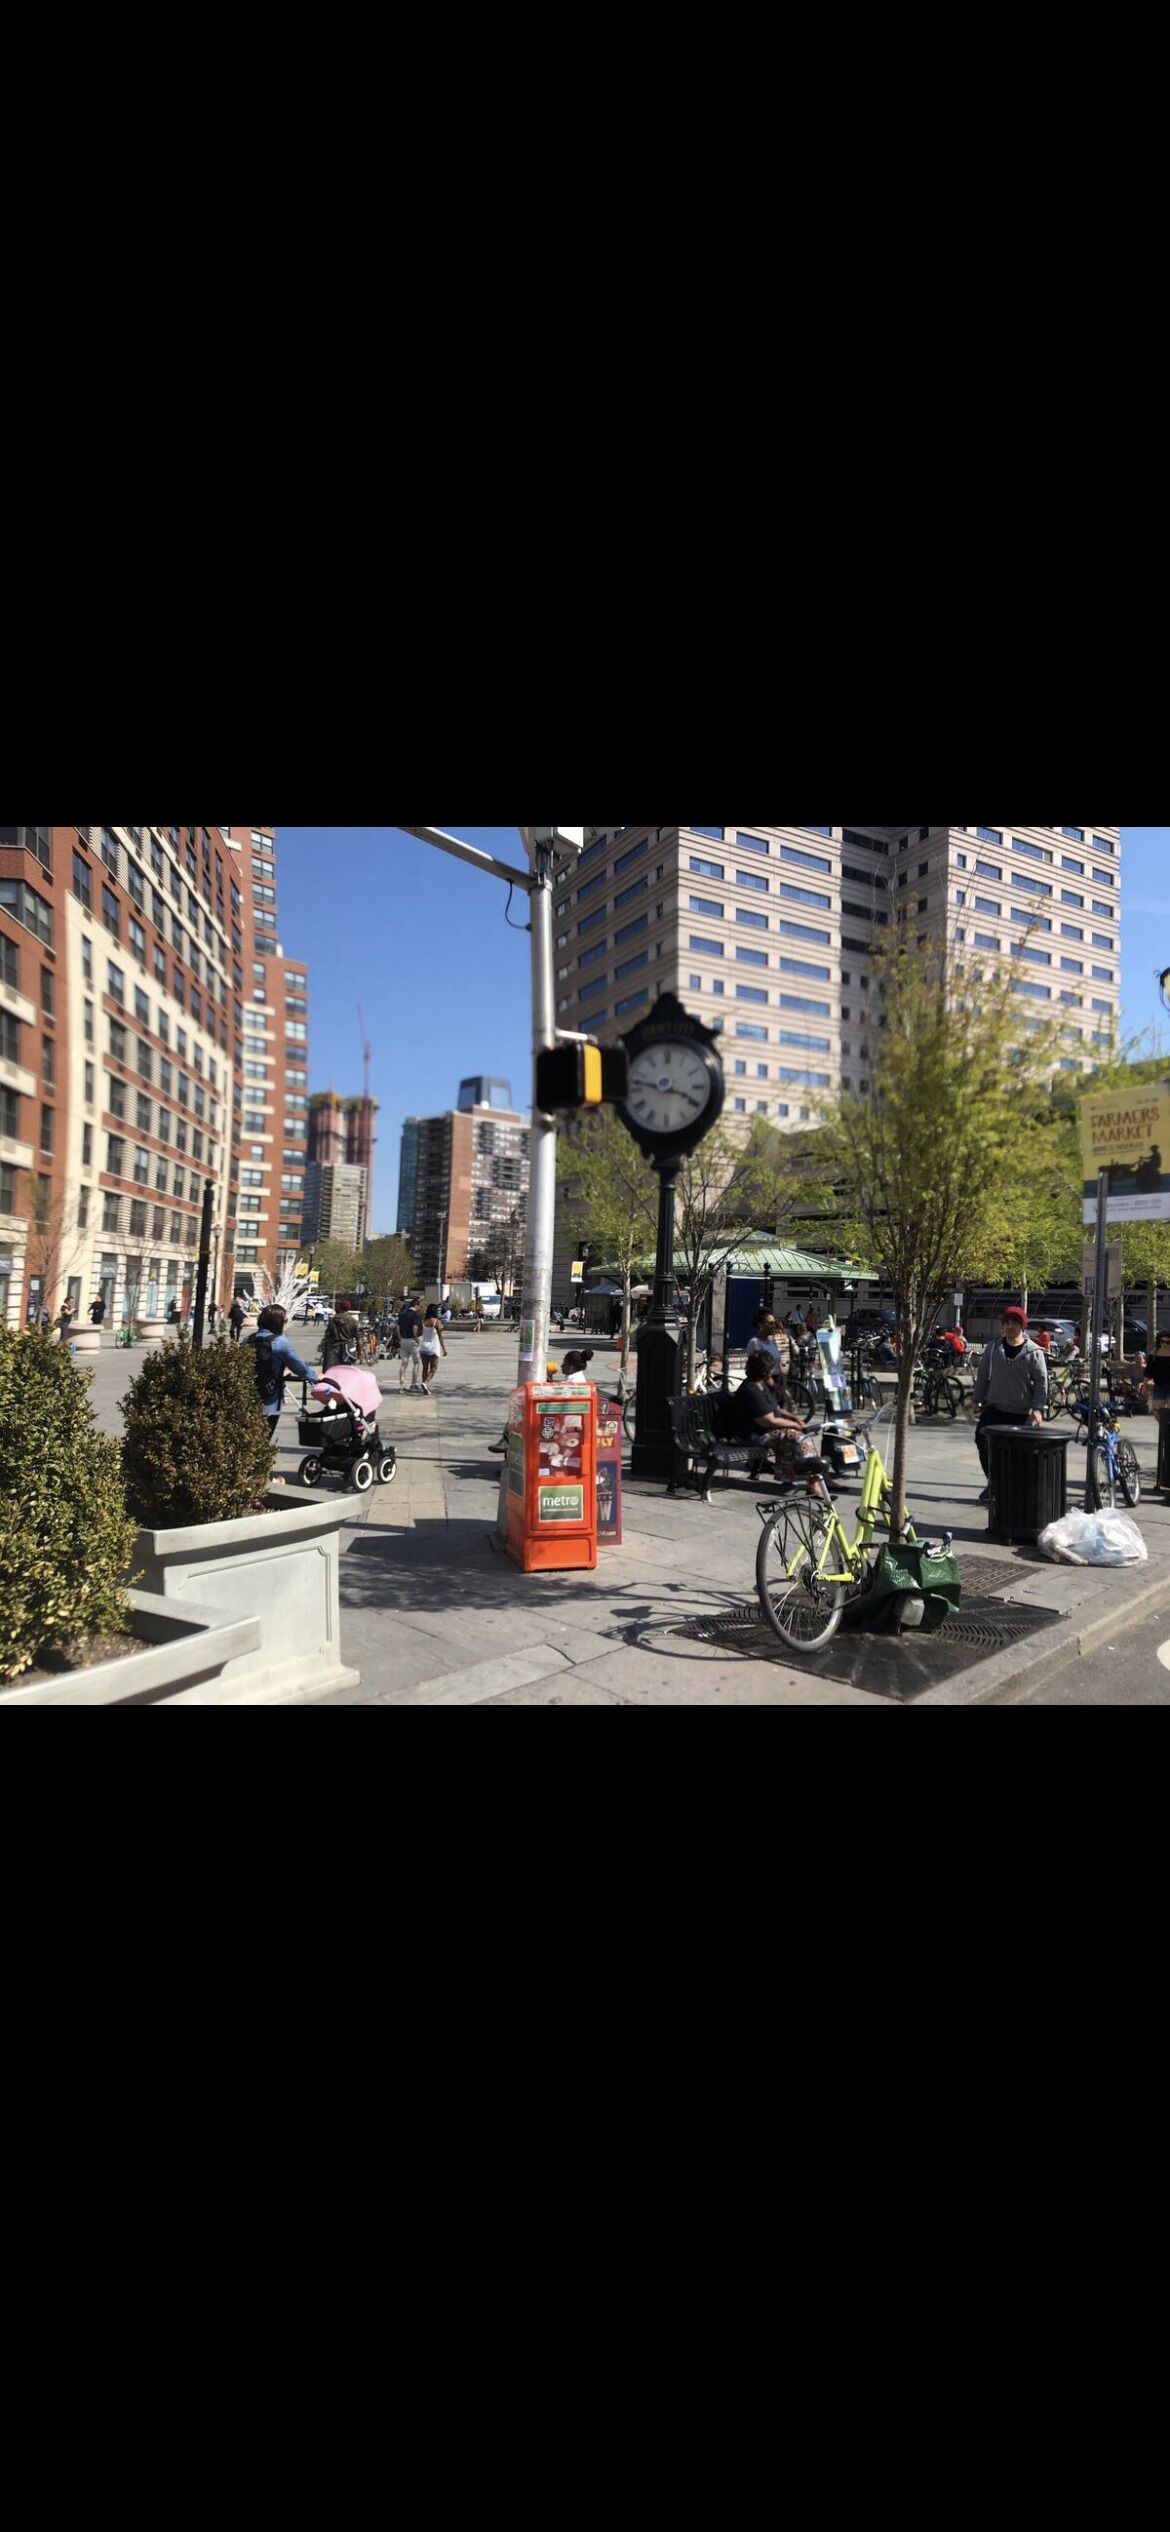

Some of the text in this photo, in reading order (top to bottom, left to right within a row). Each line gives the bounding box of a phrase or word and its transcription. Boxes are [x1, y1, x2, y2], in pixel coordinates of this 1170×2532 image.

[1091, 1106, 1160, 1128] FARMERS
[1092, 1124, 1152, 1144] MARKET
[543, 1496, 579, 1507] metro
